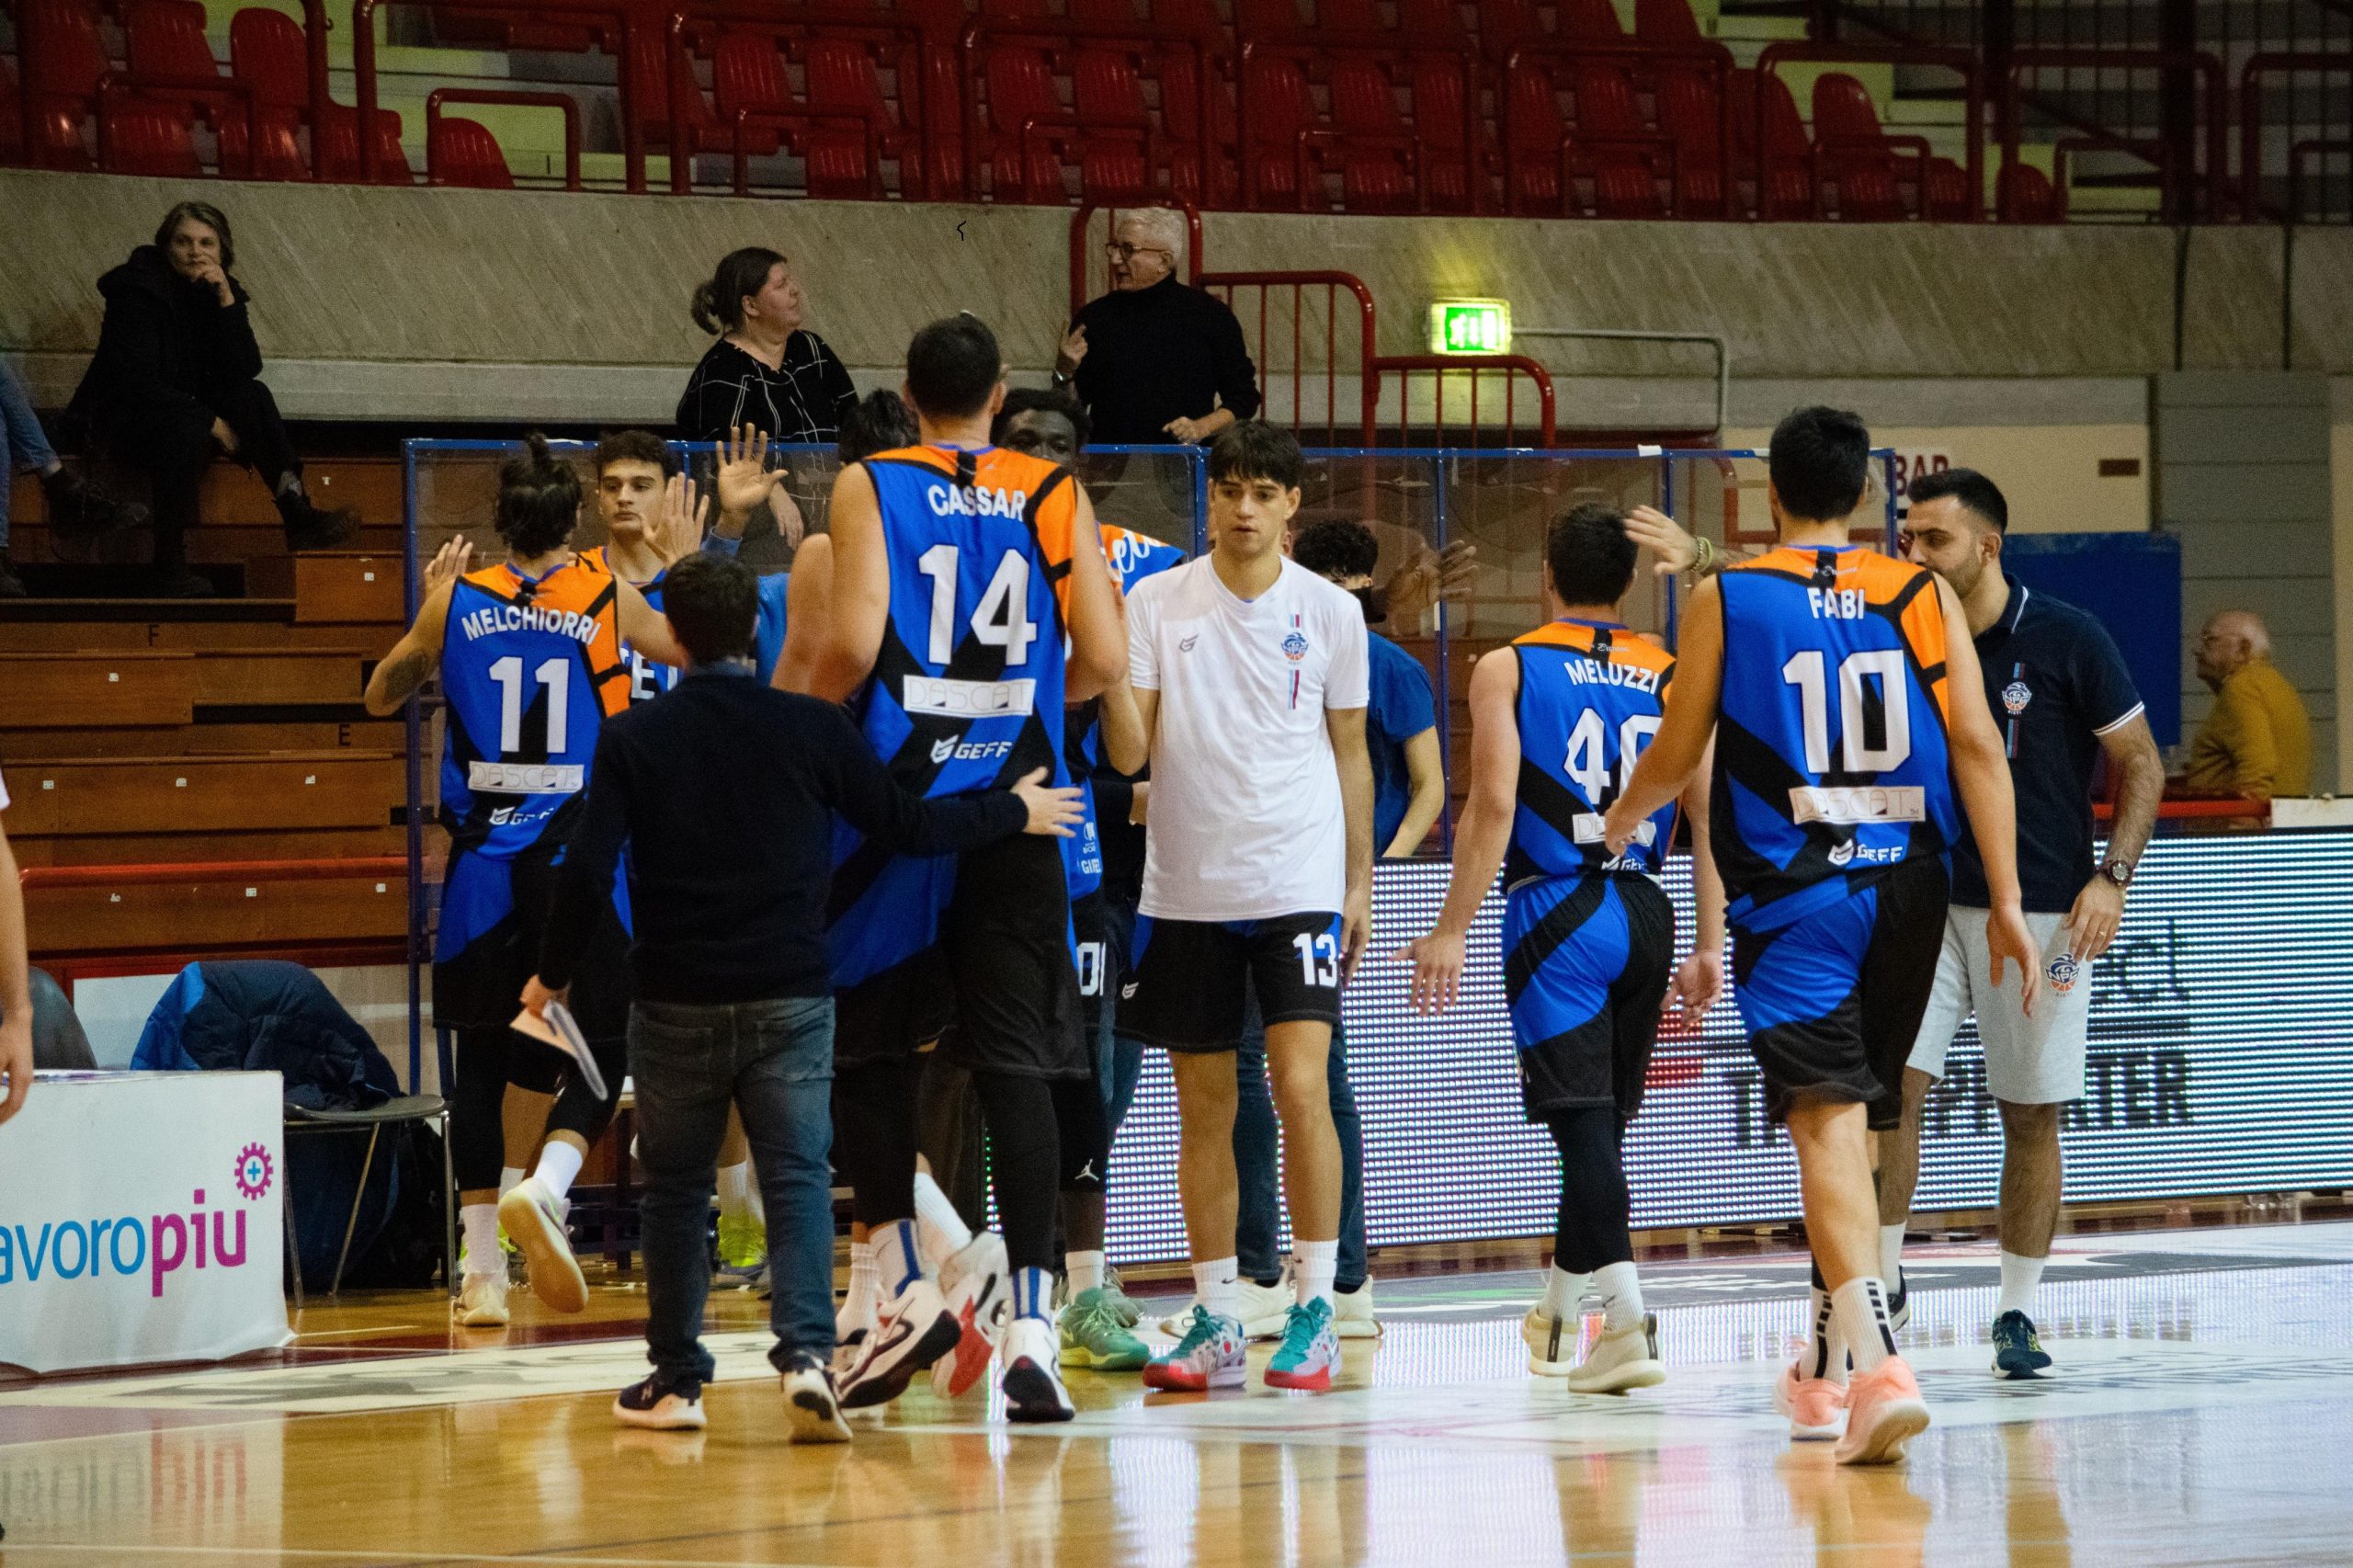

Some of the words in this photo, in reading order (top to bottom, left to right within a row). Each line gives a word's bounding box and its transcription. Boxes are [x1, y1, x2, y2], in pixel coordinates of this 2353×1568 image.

[927, 484, 1028, 522] CASSAR
[918, 544, 1037, 665] 14
[1805, 587, 1866, 619] FABI
[148, 624, 160, 647] F
[461, 605, 602, 645] MELCHIORRI
[1563, 658, 1661, 695] MELUZZI
[489, 656, 570, 754] 11
[1782, 650, 1911, 773] 10
[339, 723, 351, 747] E
[953, 740, 1013, 760] GEFF
[1856, 843, 1904, 863] GEFF
[1291, 932, 1338, 988] 13
